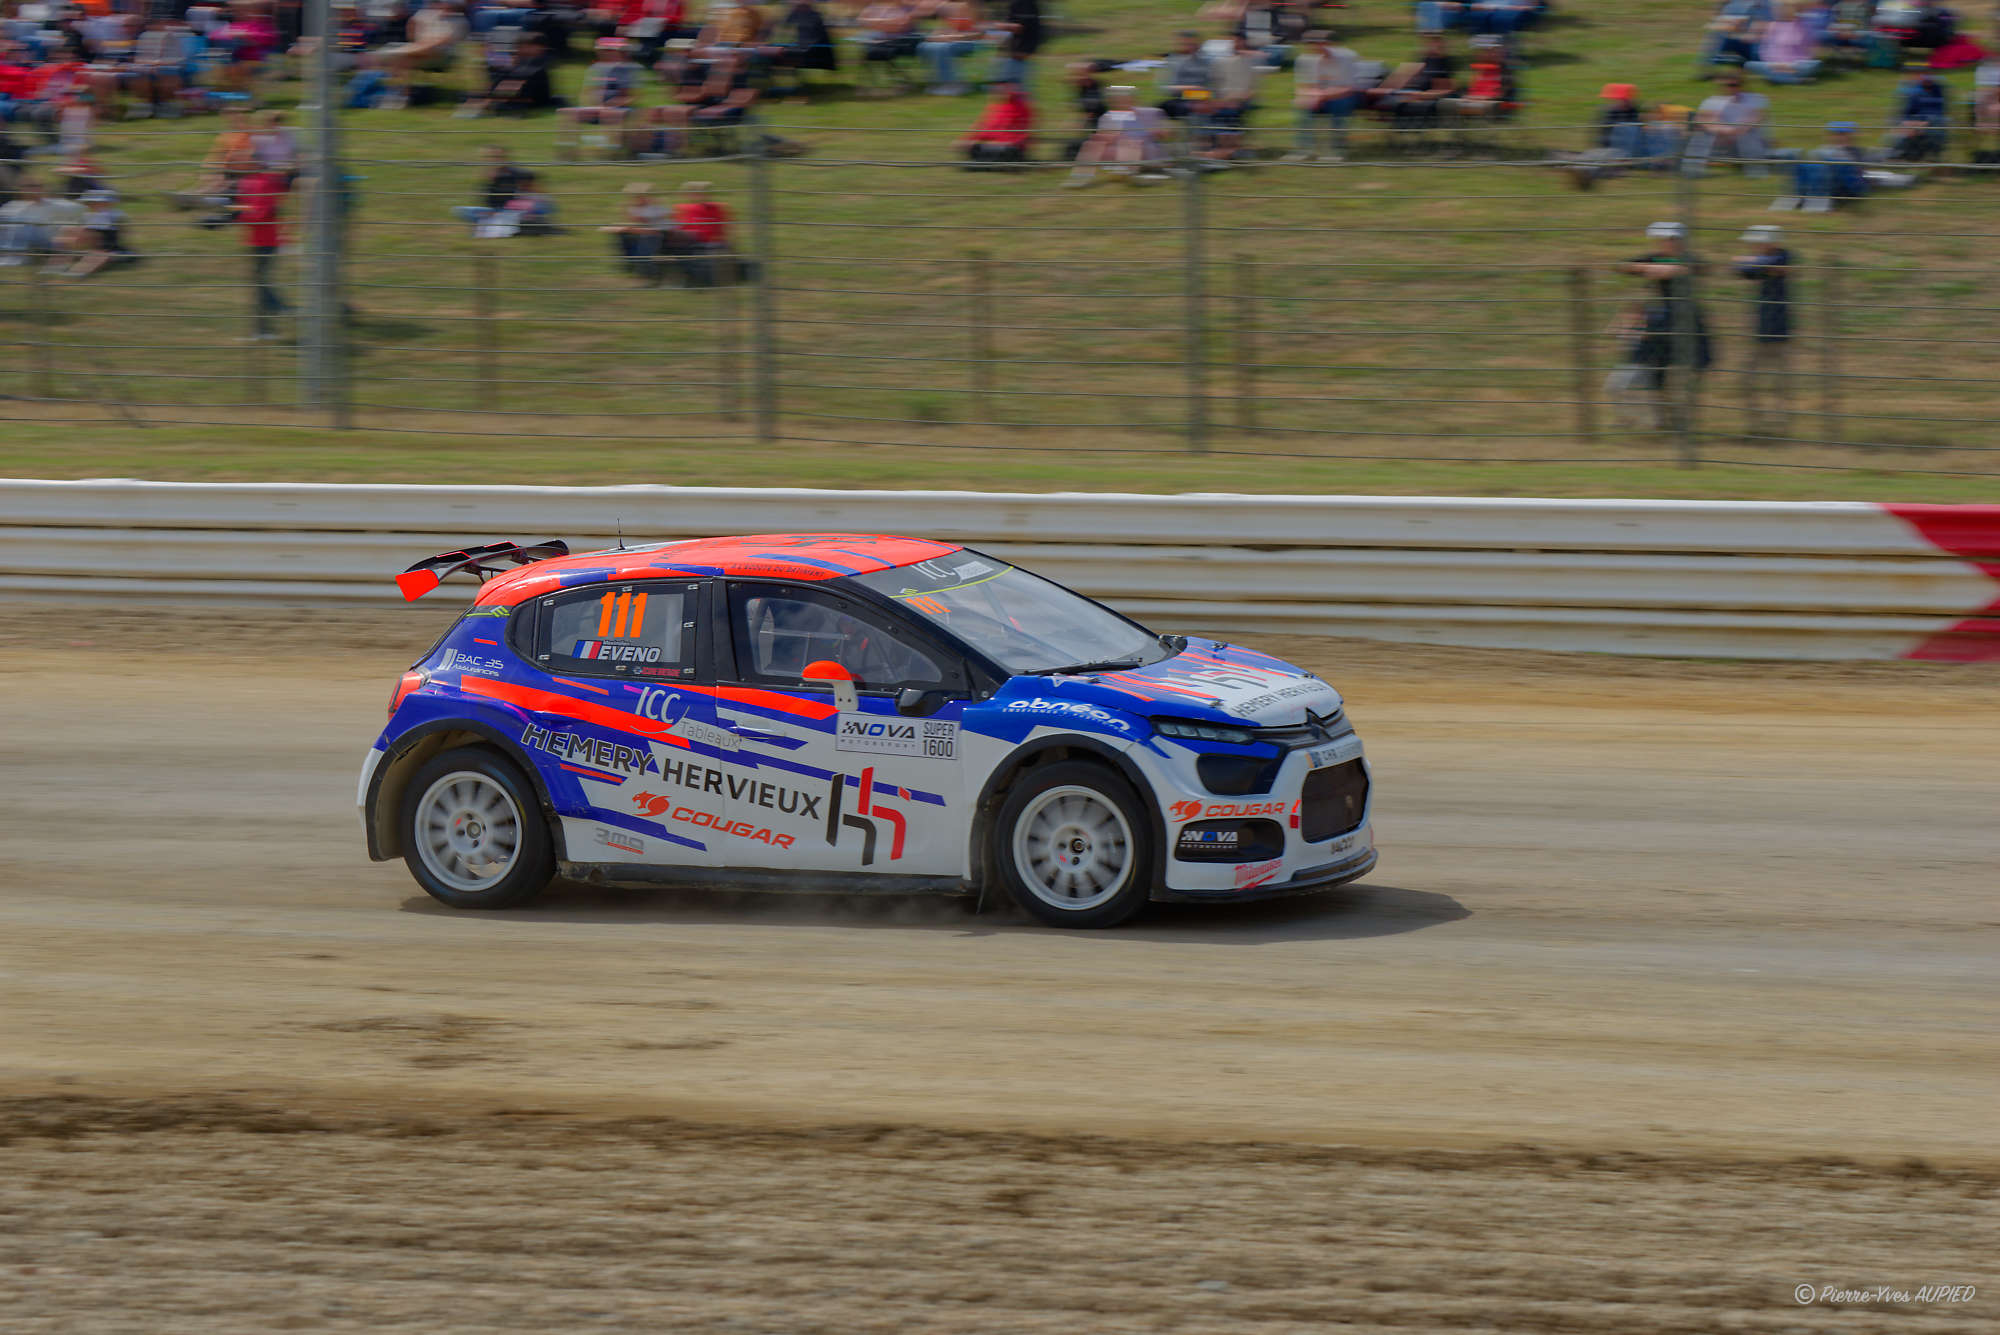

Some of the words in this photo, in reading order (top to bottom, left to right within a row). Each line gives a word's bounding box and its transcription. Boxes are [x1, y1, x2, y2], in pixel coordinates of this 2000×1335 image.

[597, 591, 648, 638] 111
[456, 653, 483, 666] BAC
[484, 658, 504, 670] 35
[597, 645, 661, 663] EVENO
[635, 686, 681, 724] ICC
[680, 720, 740, 749] Tableaux
[842, 721, 916, 739] NOVA
[923, 721, 955, 737] SUPER
[922, 740, 954, 757] 1600
[520, 722, 655, 776] HEMERY
[662, 757, 823, 820] HERVIEUX
[1204, 802, 1286, 818] COUGAR
[671, 806, 796, 850] COUGAR
[1180, 831, 1239, 842] NOVA
